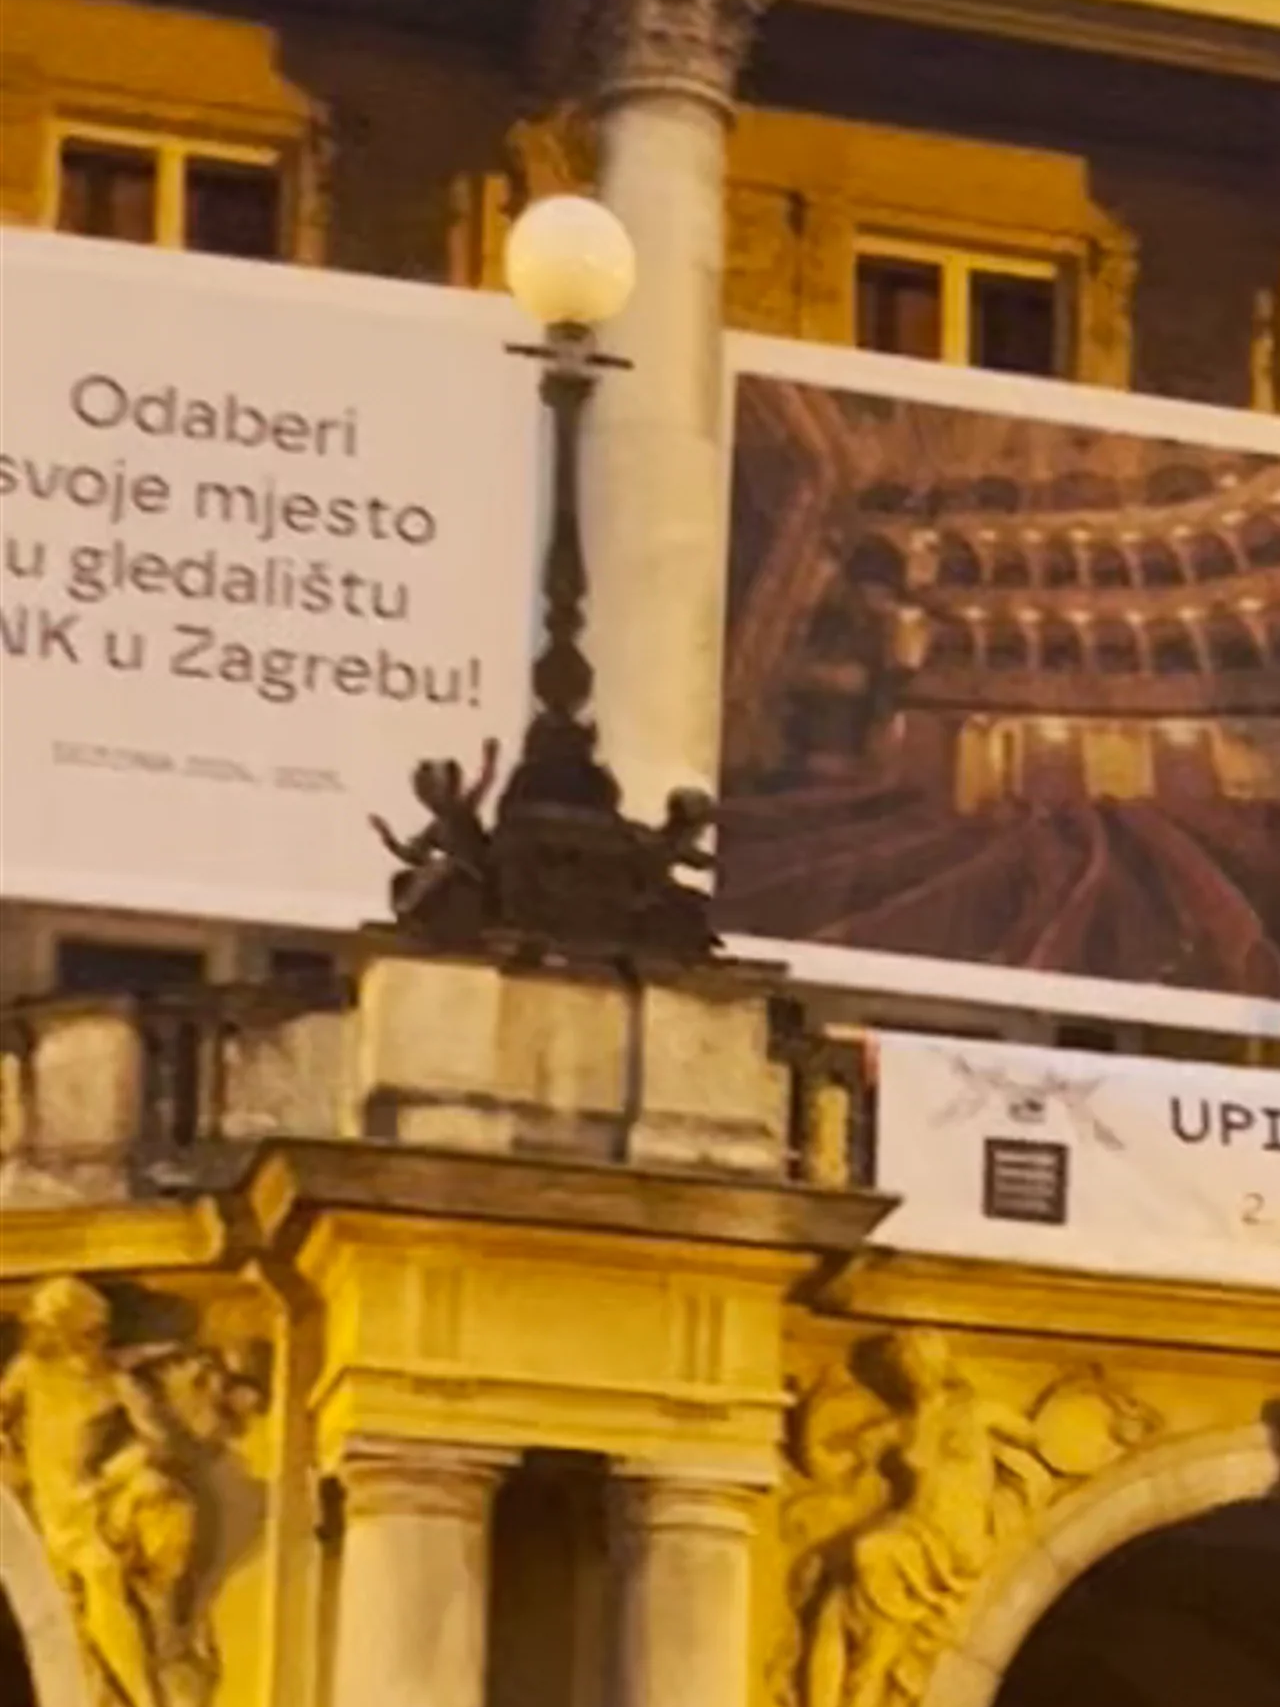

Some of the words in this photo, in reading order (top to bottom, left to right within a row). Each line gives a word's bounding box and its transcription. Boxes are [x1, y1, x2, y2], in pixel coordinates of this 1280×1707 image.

[69, 373, 358, 458] Odaberi
[0, 452, 171, 525] svoje
[195, 475, 437, 546] mjesto
[5, 537, 46, 579] u
[67, 538, 410, 621] gledalištu
[105, 630, 144, 671] u
[169, 623, 483, 708] Zagrebu!
